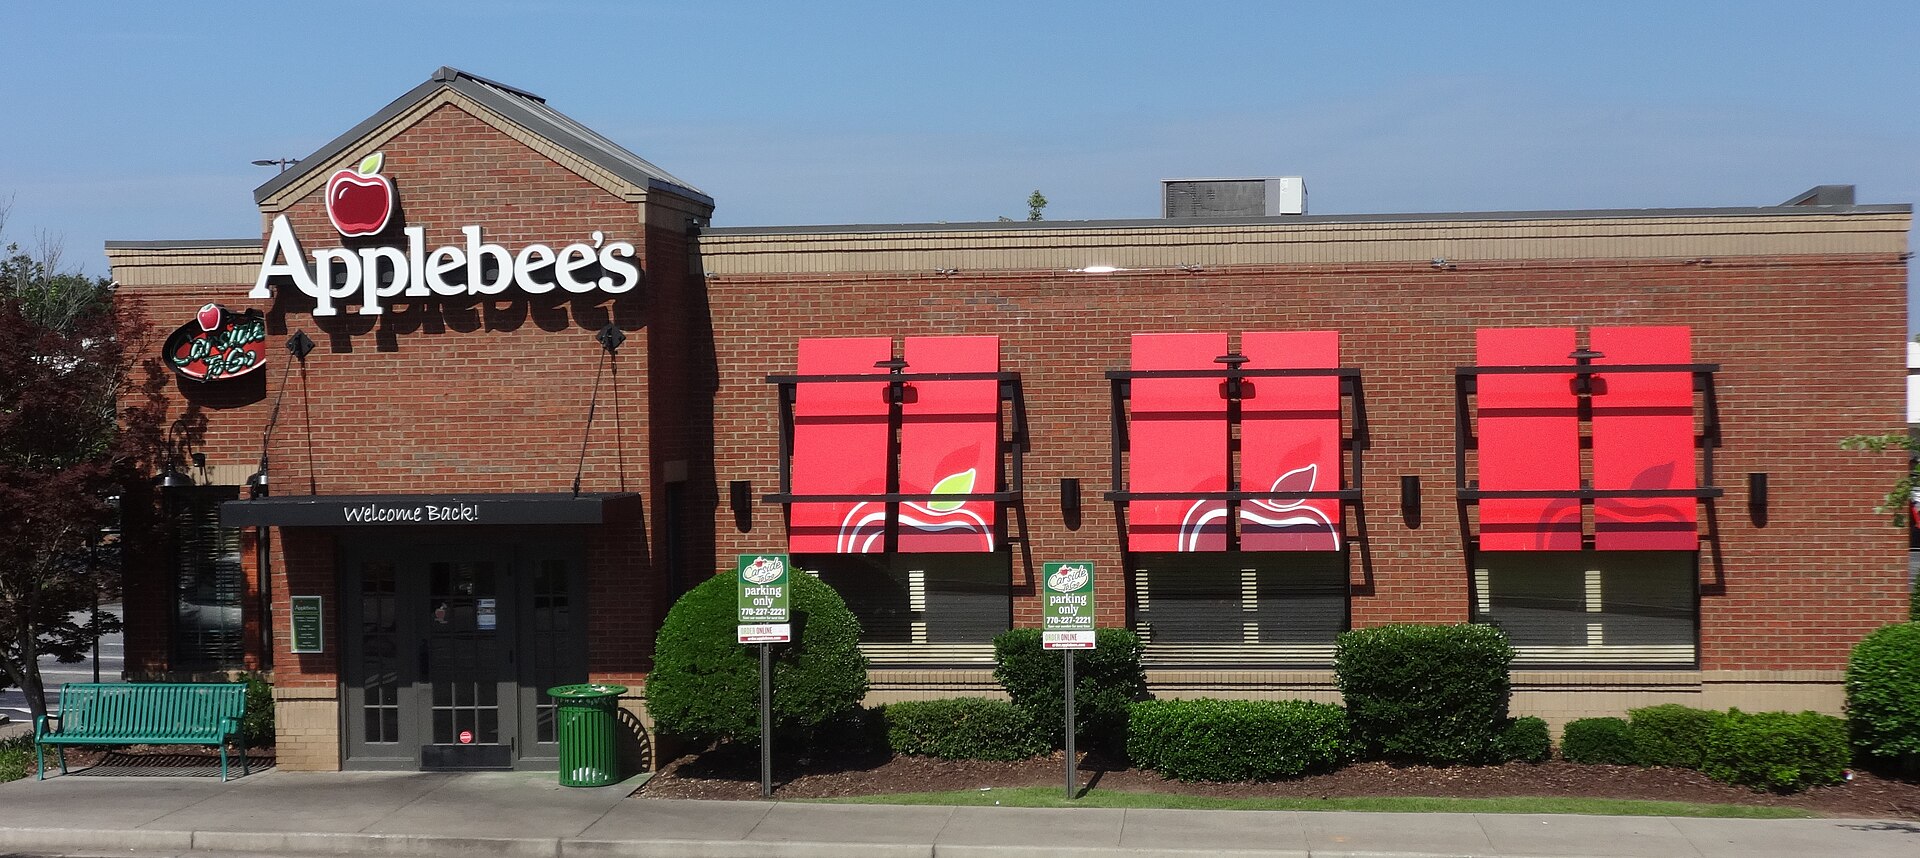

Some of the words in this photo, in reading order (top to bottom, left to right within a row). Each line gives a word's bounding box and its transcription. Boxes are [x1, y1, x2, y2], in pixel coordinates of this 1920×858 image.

[248, 214, 639, 316] Applebee's
[344, 504, 422, 522] Welcome
[425, 503, 479, 521] Back!
[744, 558, 781, 579] Carside
[1049, 565, 1087, 587] Carside
[745, 585, 782, 598] parking
[753, 596, 774, 608] only
[1050, 594, 1087, 606] parking
[1058, 604, 1079, 616] only
[1046, 616, 1091, 624] 770-227-2221
[756, 626, 772, 634] ONLINE
[1061, 633, 1077, 641] ONLINE
